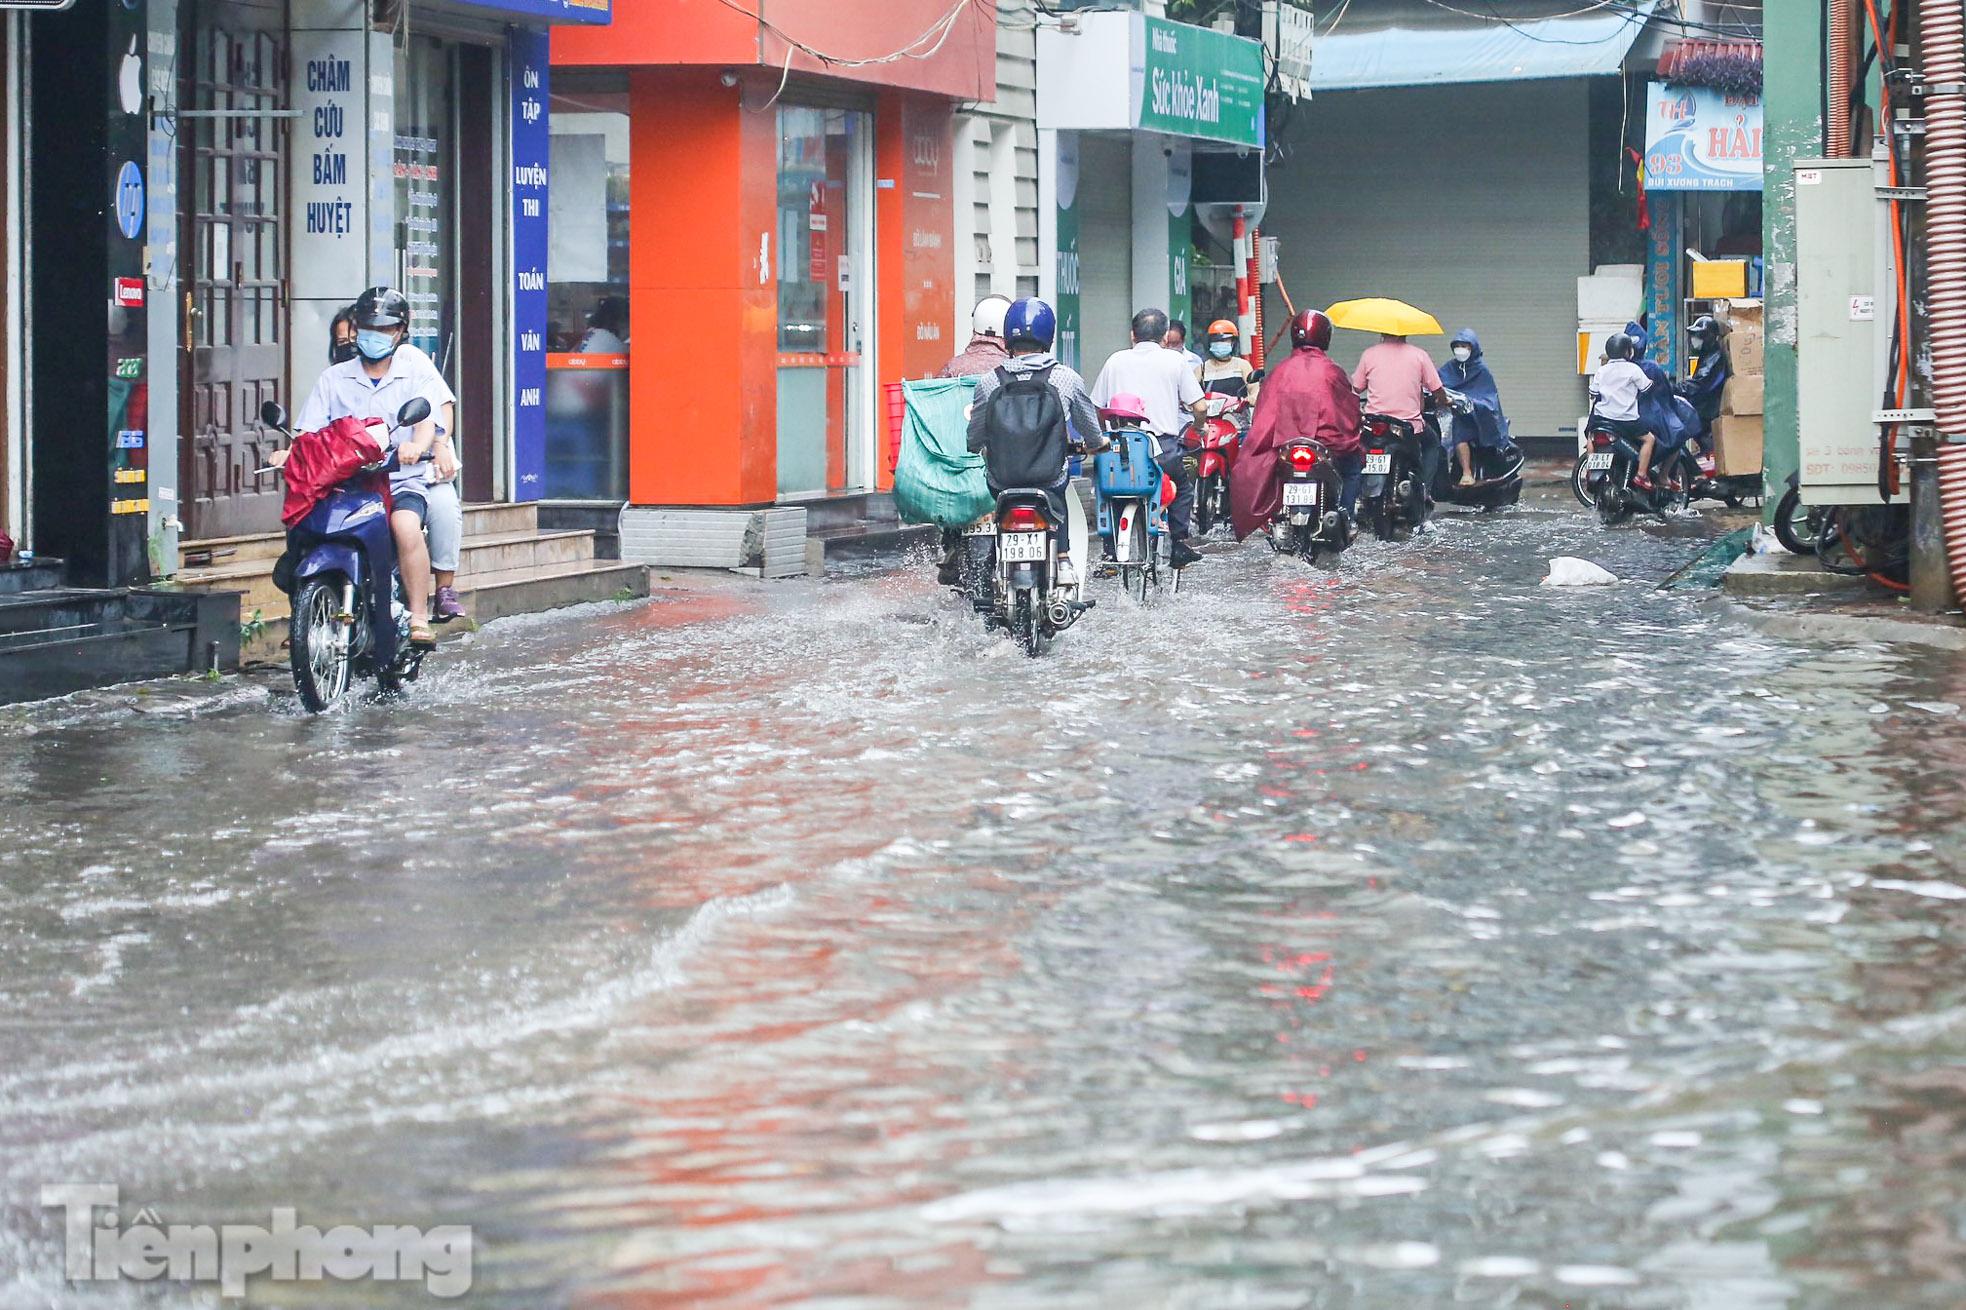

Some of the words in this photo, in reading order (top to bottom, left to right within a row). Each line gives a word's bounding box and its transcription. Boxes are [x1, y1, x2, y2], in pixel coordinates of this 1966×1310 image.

[307, 54, 351, 92] CHÂM
[523, 65, 539, 89] ÔN
[1151, 66, 1171, 116] Sức
[1171, 69, 1195, 120] khỏe
[1195, 75, 1219, 123] Xanh
[314, 99, 344, 138] CỨU
[522, 97, 541, 124] TẬP
[1707, 113, 1762, 159] HẢI
[313, 143, 346, 185] BẤM
[515, 162, 547, 189] LUYỆN
[306, 196, 352, 239] HUYỆT
[522, 199, 539, 216] THI
[518, 267, 544, 291] TOÁN
[520, 329, 540, 351] VĂN
[520, 388, 540, 407] ANH
